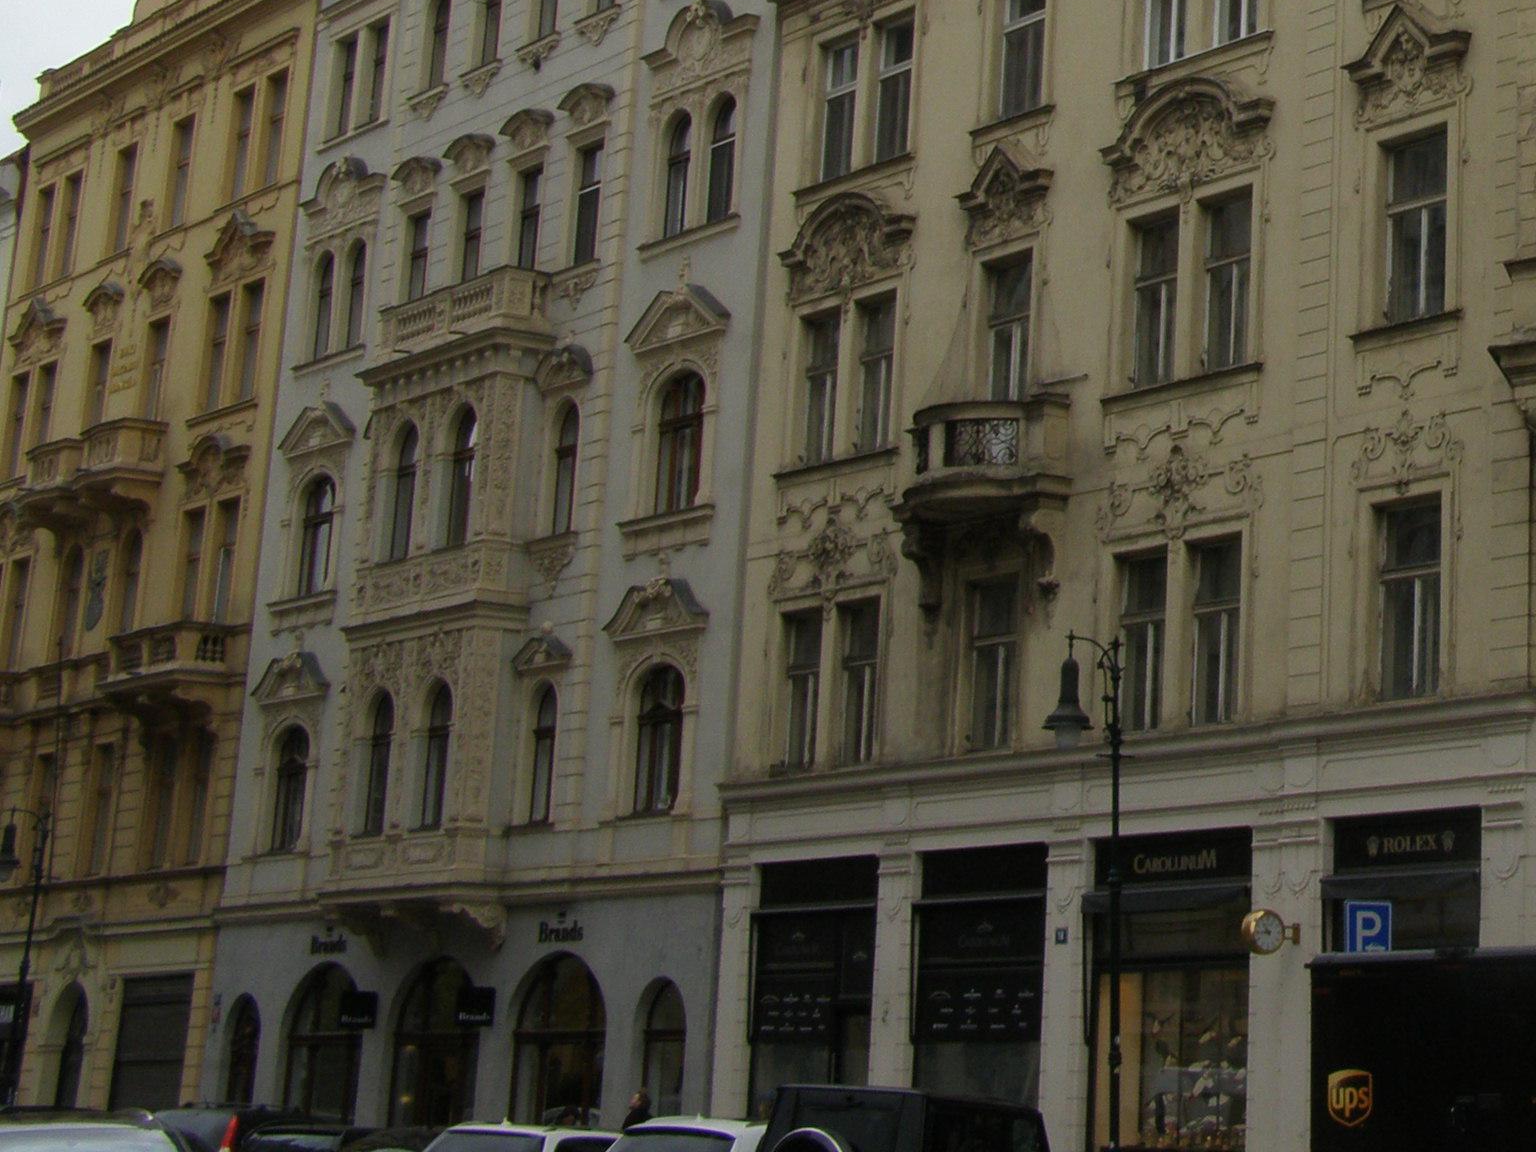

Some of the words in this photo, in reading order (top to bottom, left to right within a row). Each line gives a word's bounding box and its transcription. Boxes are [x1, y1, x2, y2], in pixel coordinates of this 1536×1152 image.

[1383, 834, 1437, 853] ROLEX
[1133, 849, 1217, 873] CAROLLINUM
[538, 919, 584, 944] Brands
[1356, 910, 1382, 952] P
[310, 934, 347, 955] Brands
[1332, 1087, 1369, 1118] ups
